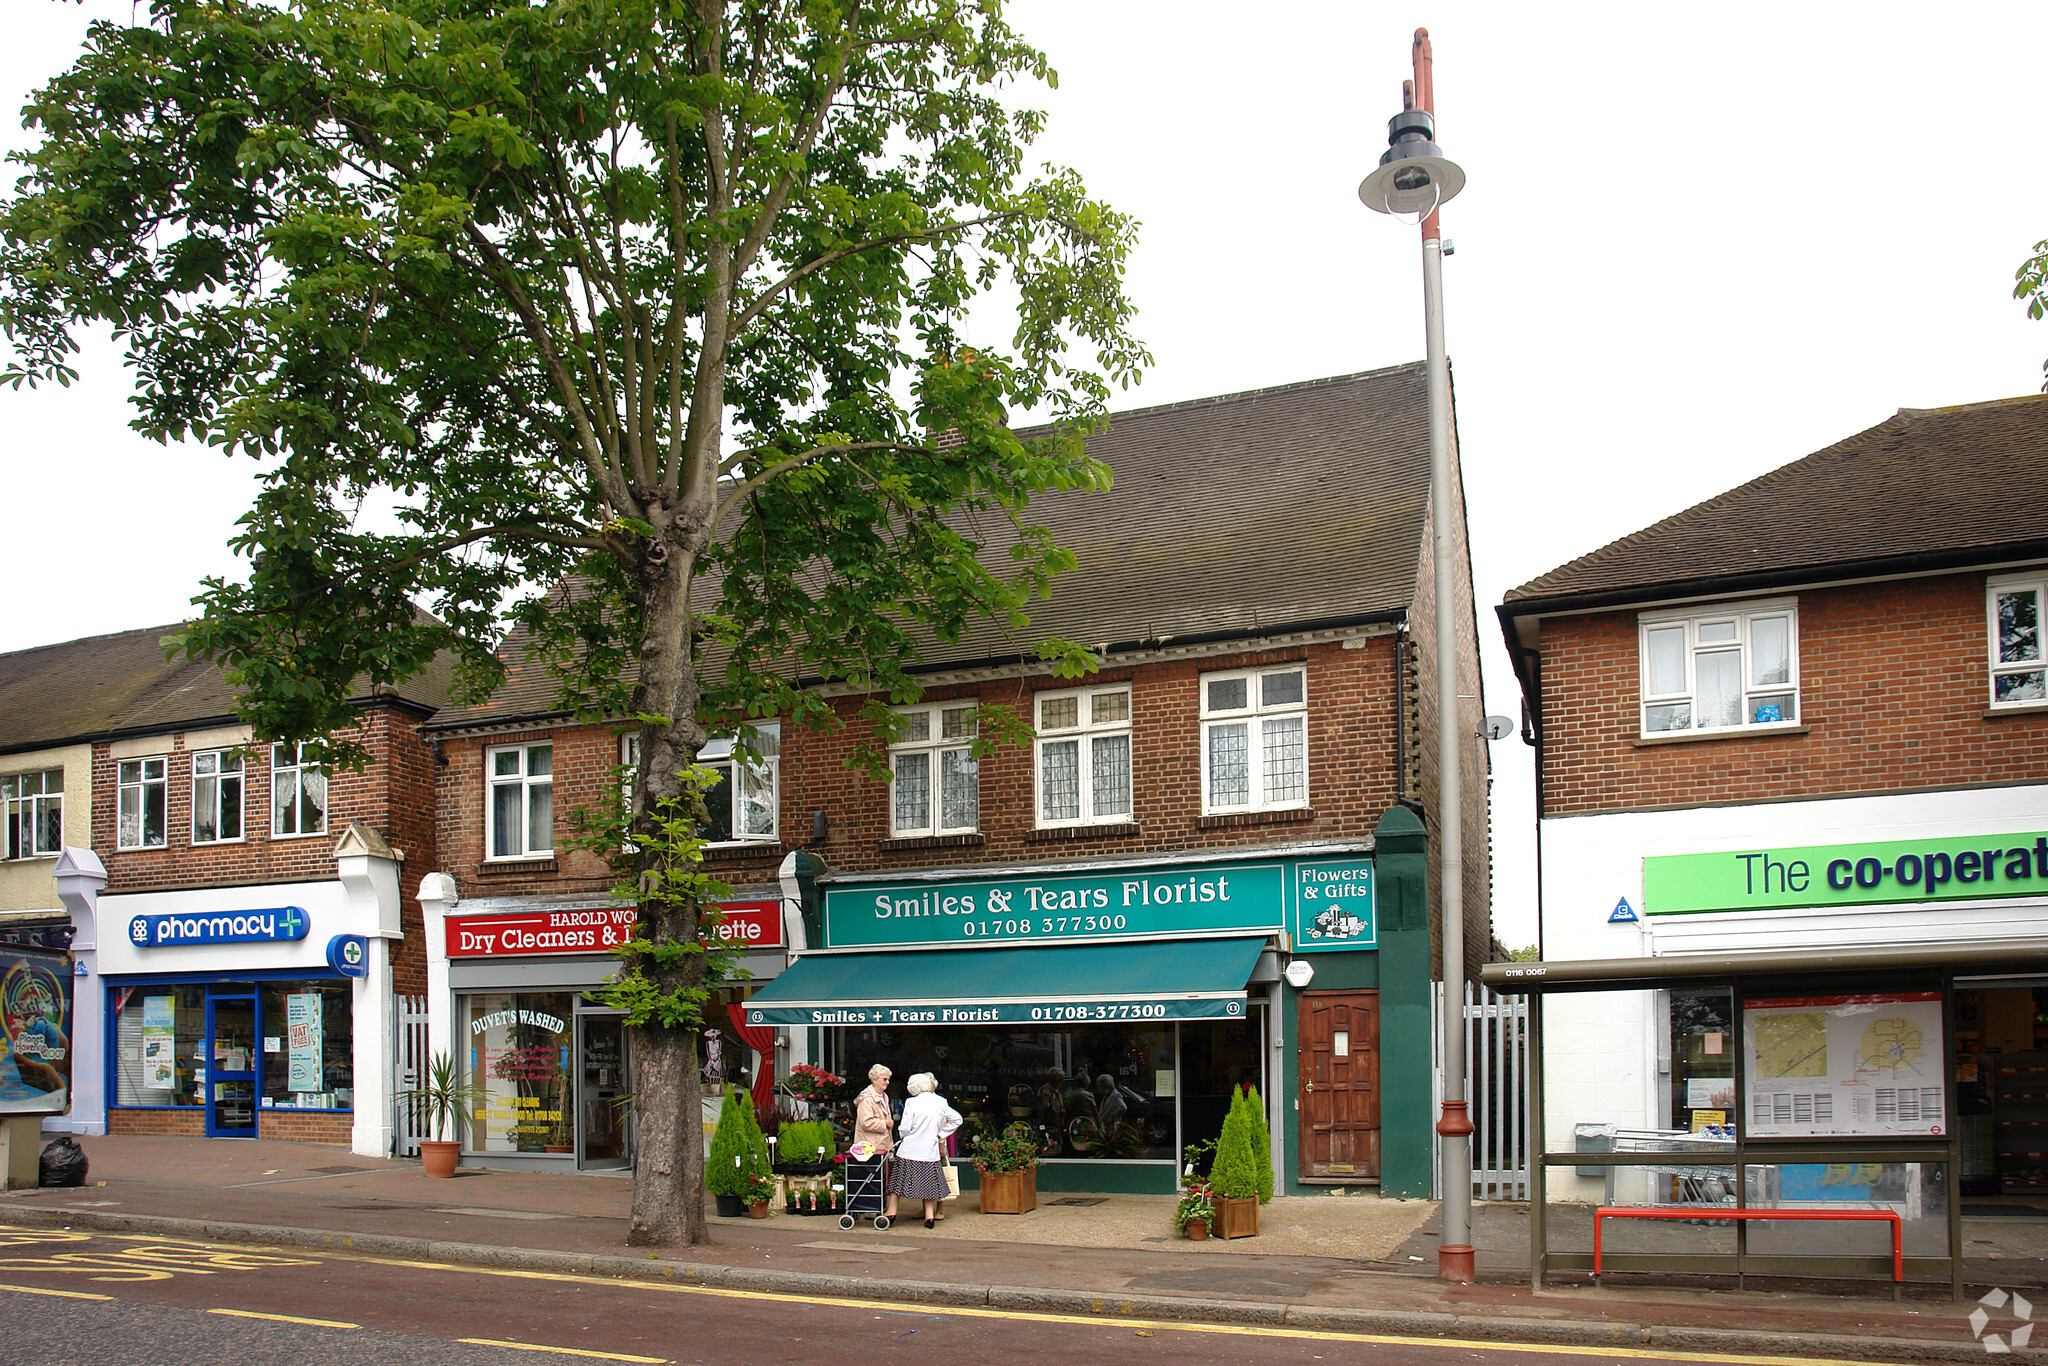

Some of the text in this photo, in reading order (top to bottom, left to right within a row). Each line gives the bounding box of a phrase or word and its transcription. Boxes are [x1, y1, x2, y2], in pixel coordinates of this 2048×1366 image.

[1736, 837, 2048, 894] The co-operat
[1302, 868, 1369, 883] Flowers
[874, 875, 1231, 919] Smiles & Tears Florist
[1304, 883, 1367, 899] & Gifts
[550, 911, 607, 927] HAROLD
[963, 914, 1127, 937] 01708 377300
[157, 914, 275, 943] pharmacy
[460, 931, 495, 953] Dry
[501, 928, 595, 949] Cleaners
[601, 925, 619, 945] &
[341, 963, 364, 971] pharmacy
[1505, 967, 1548, 977] 0116 0067
[812, 1004, 1166, 1023] Smiles + Tears Florist 01708-377300
[471, 1009, 565, 1035] DUVET'S WASHED
[19, 1033, 44, 1045] Planet
[291, 1025, 307, 1038] VAT
[15, 1042, 47, 1054] Havering
[293, 1036, 309, 1047] FREE
